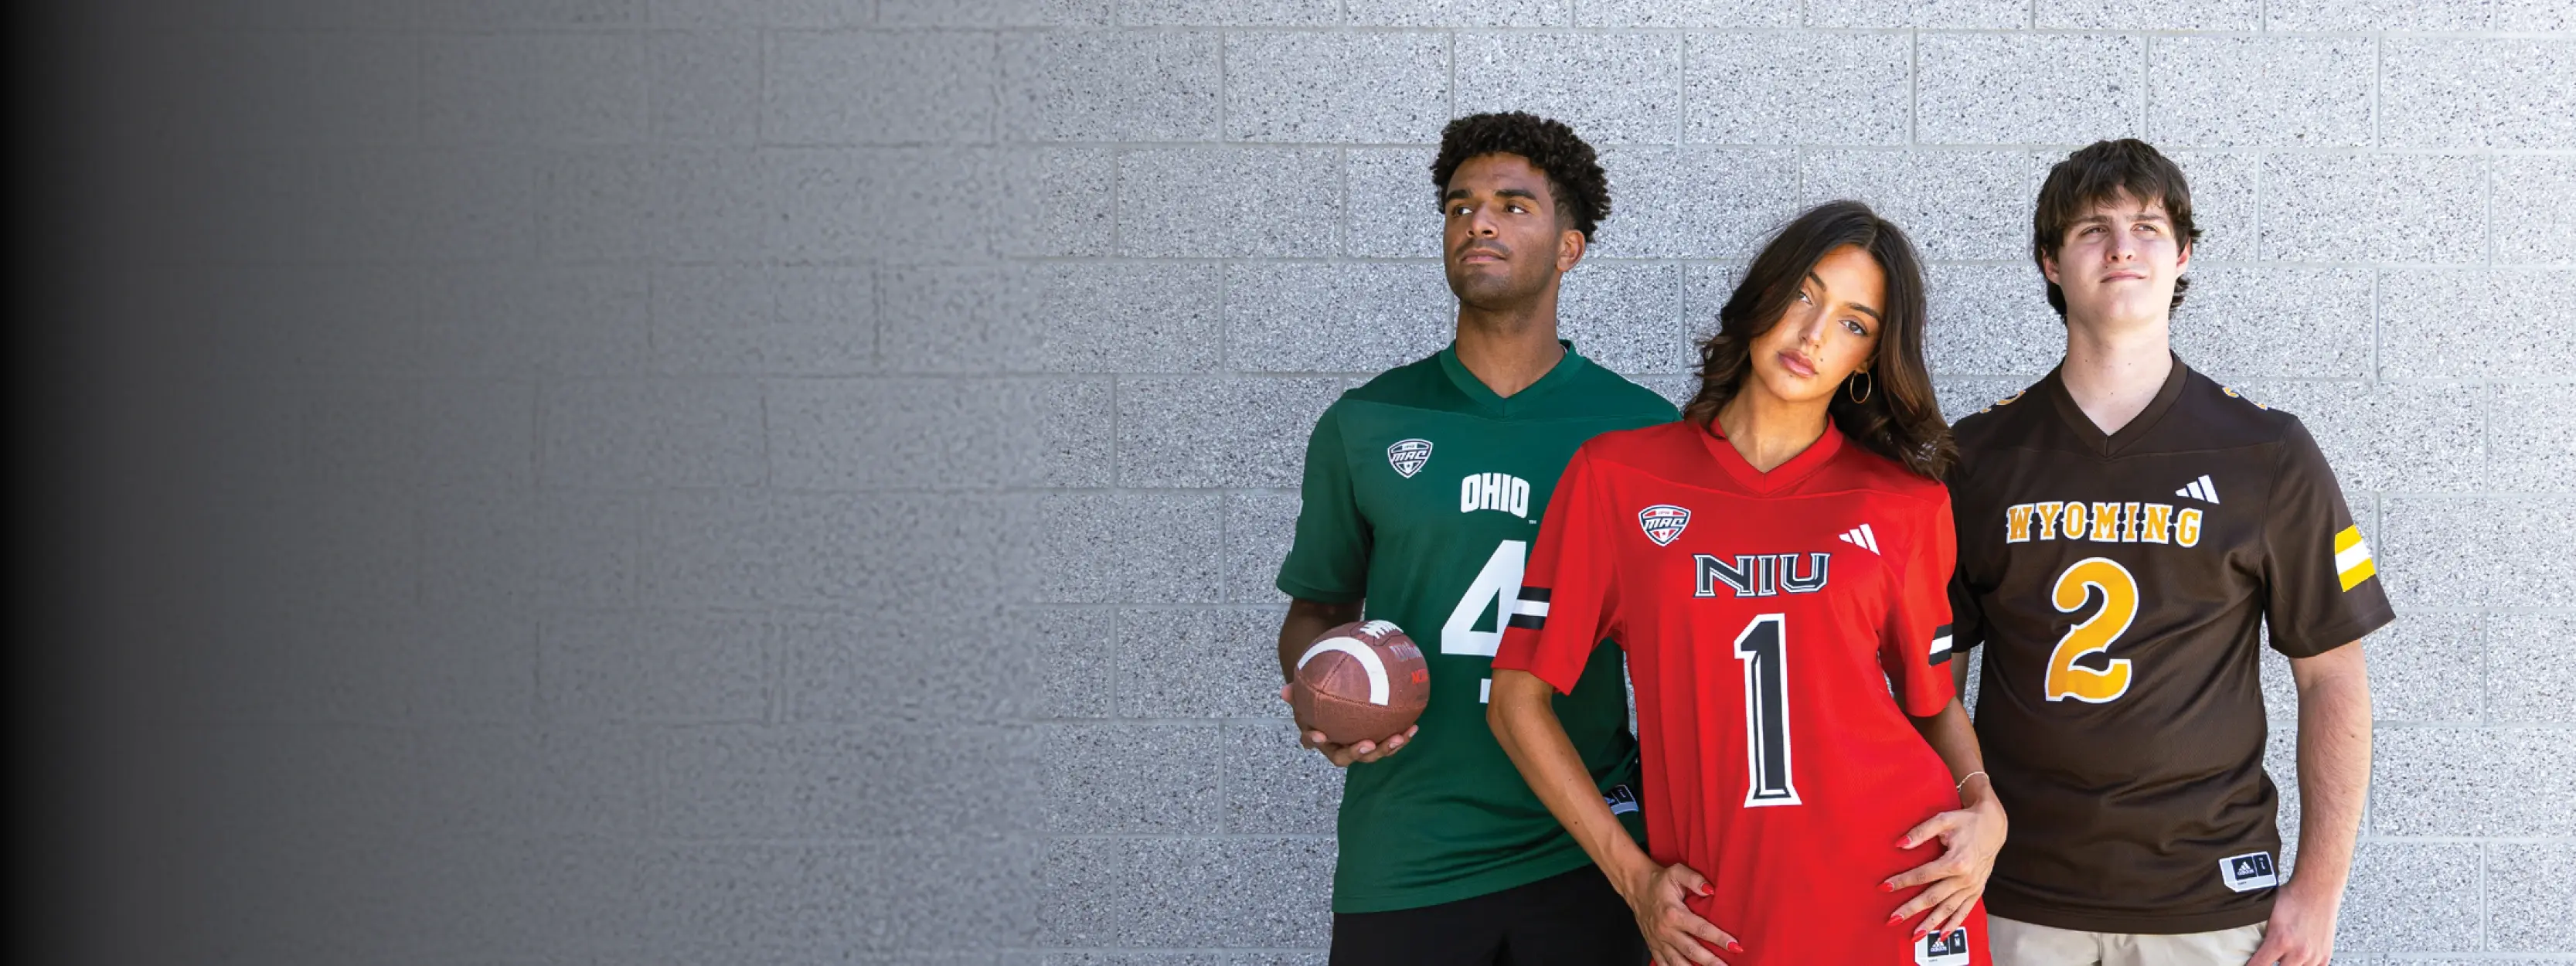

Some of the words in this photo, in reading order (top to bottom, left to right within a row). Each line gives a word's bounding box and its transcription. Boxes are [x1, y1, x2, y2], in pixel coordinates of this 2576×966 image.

[1392, 450, 1428, 462] MAC
[1461, 472, 1530, 519] OHIO
[1644, 518, 1686, 530] MAC
[2006, 501, 2203, 548] WYOMING
[1692, 553, 1831, 597] NIU
[1441, 539, 1526, 703] 4
[2045, 556, 2139, 704] 2
[1734, 613, 1802, 808] 1
